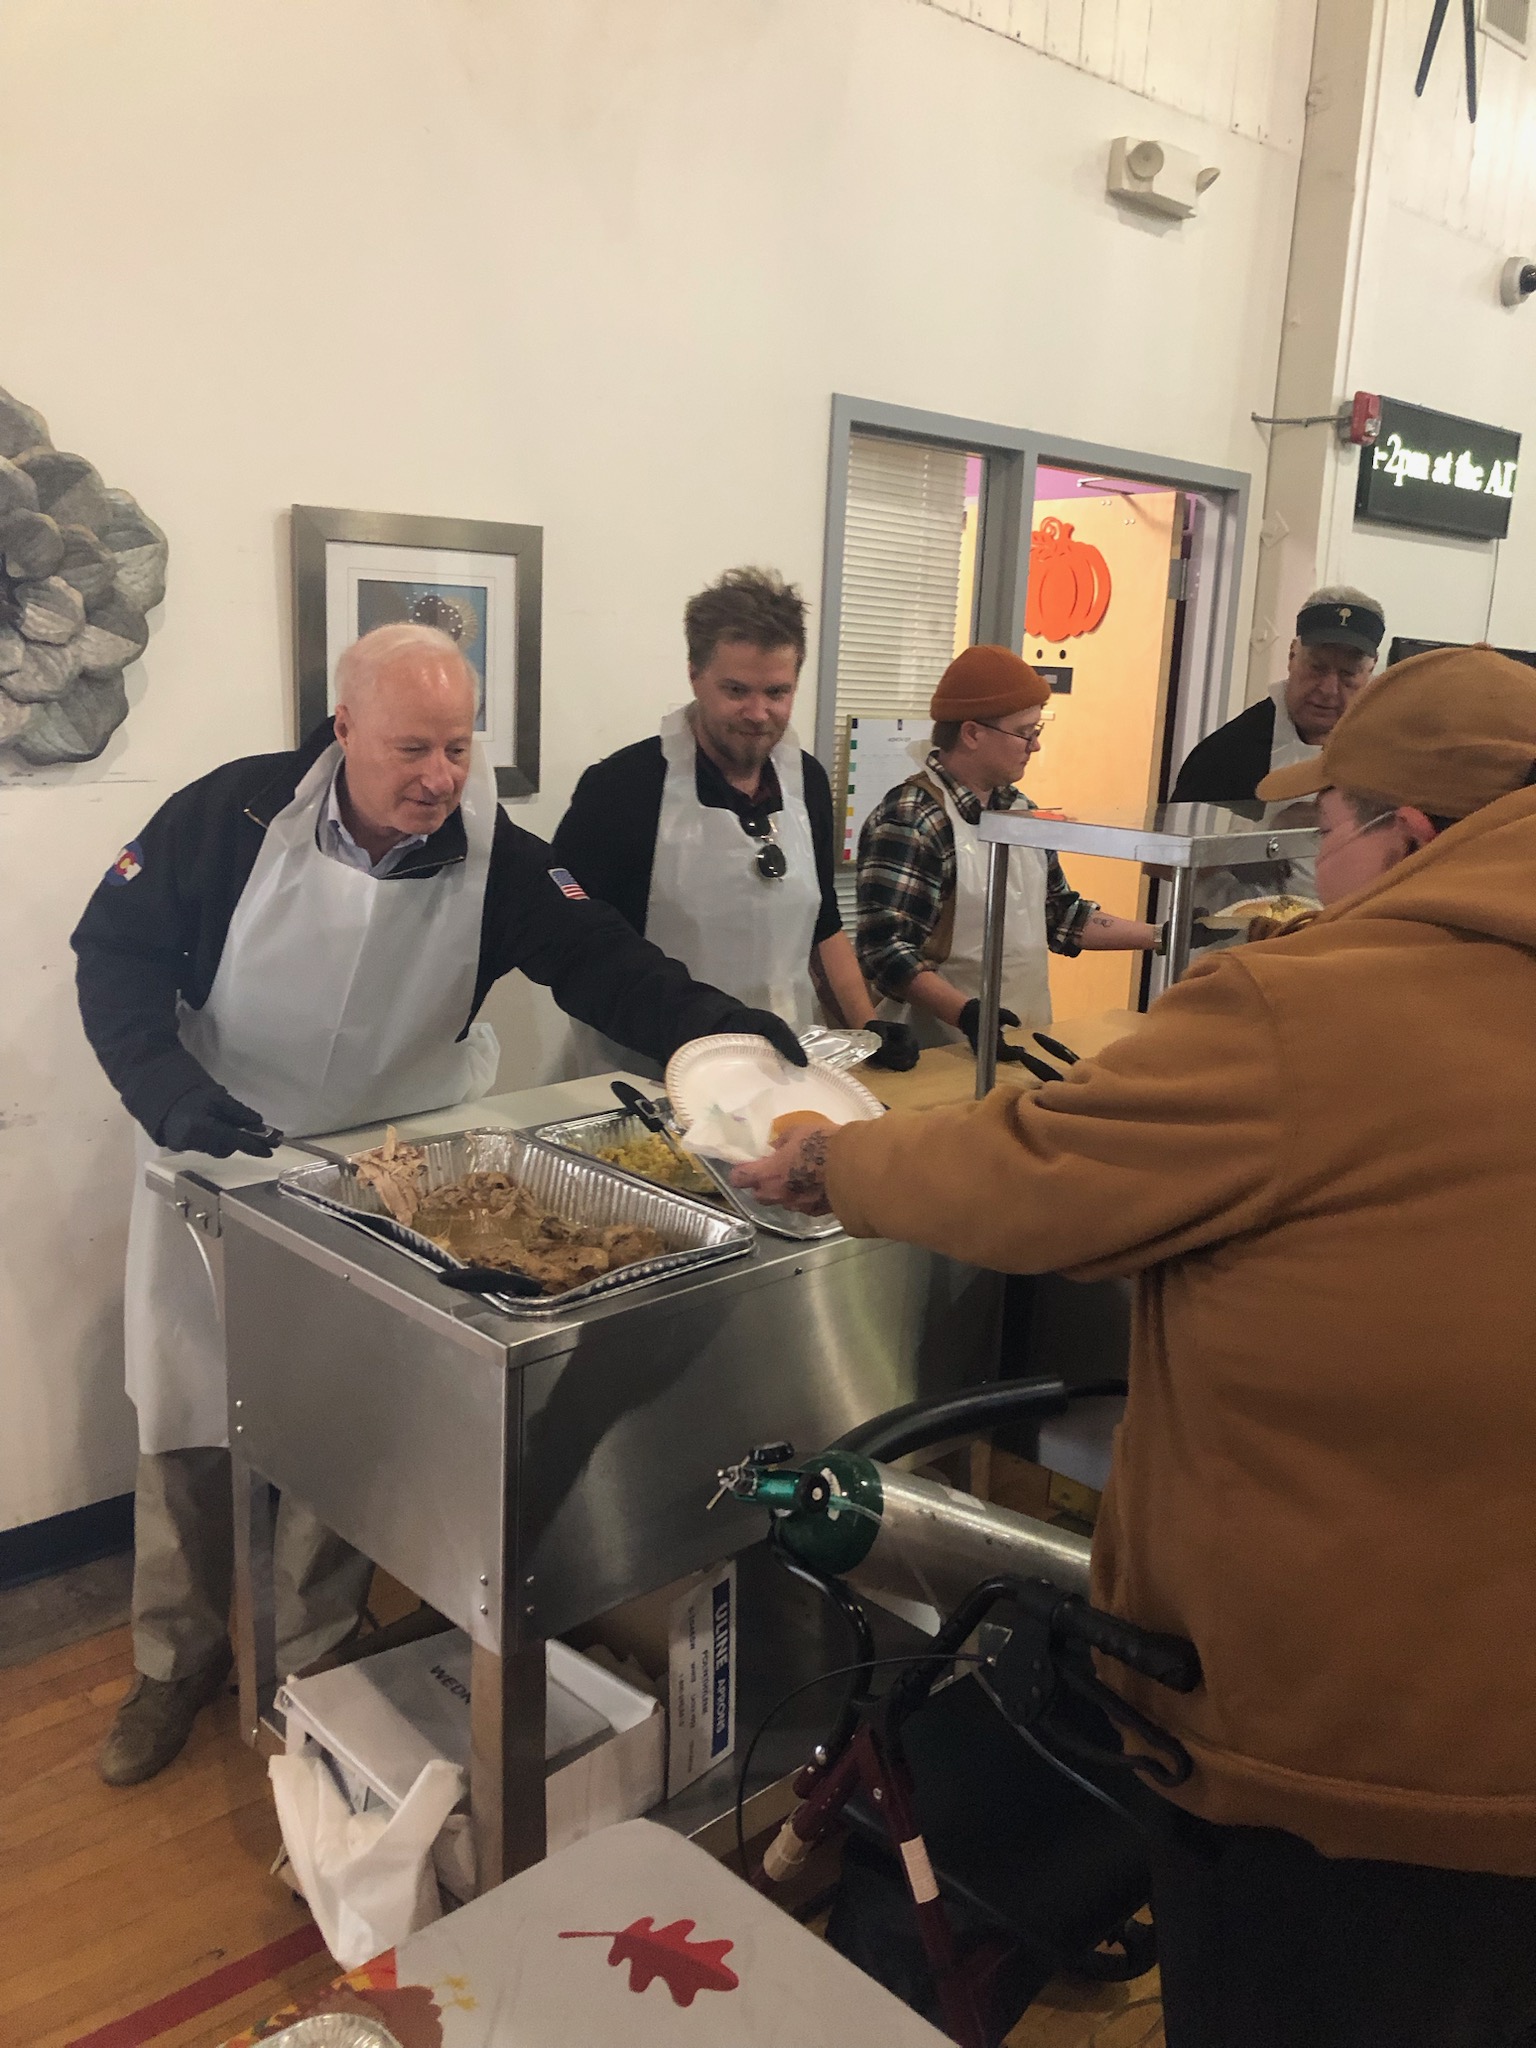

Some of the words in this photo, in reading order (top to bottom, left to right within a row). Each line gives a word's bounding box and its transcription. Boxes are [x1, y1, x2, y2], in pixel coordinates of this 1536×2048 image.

[1431, 451, 1453, 485] at
[1454, 450, 1485, 492] the
[714, 1600, 729, 1671] ULINE
[716, 1678, 726, 1734] APRONS
